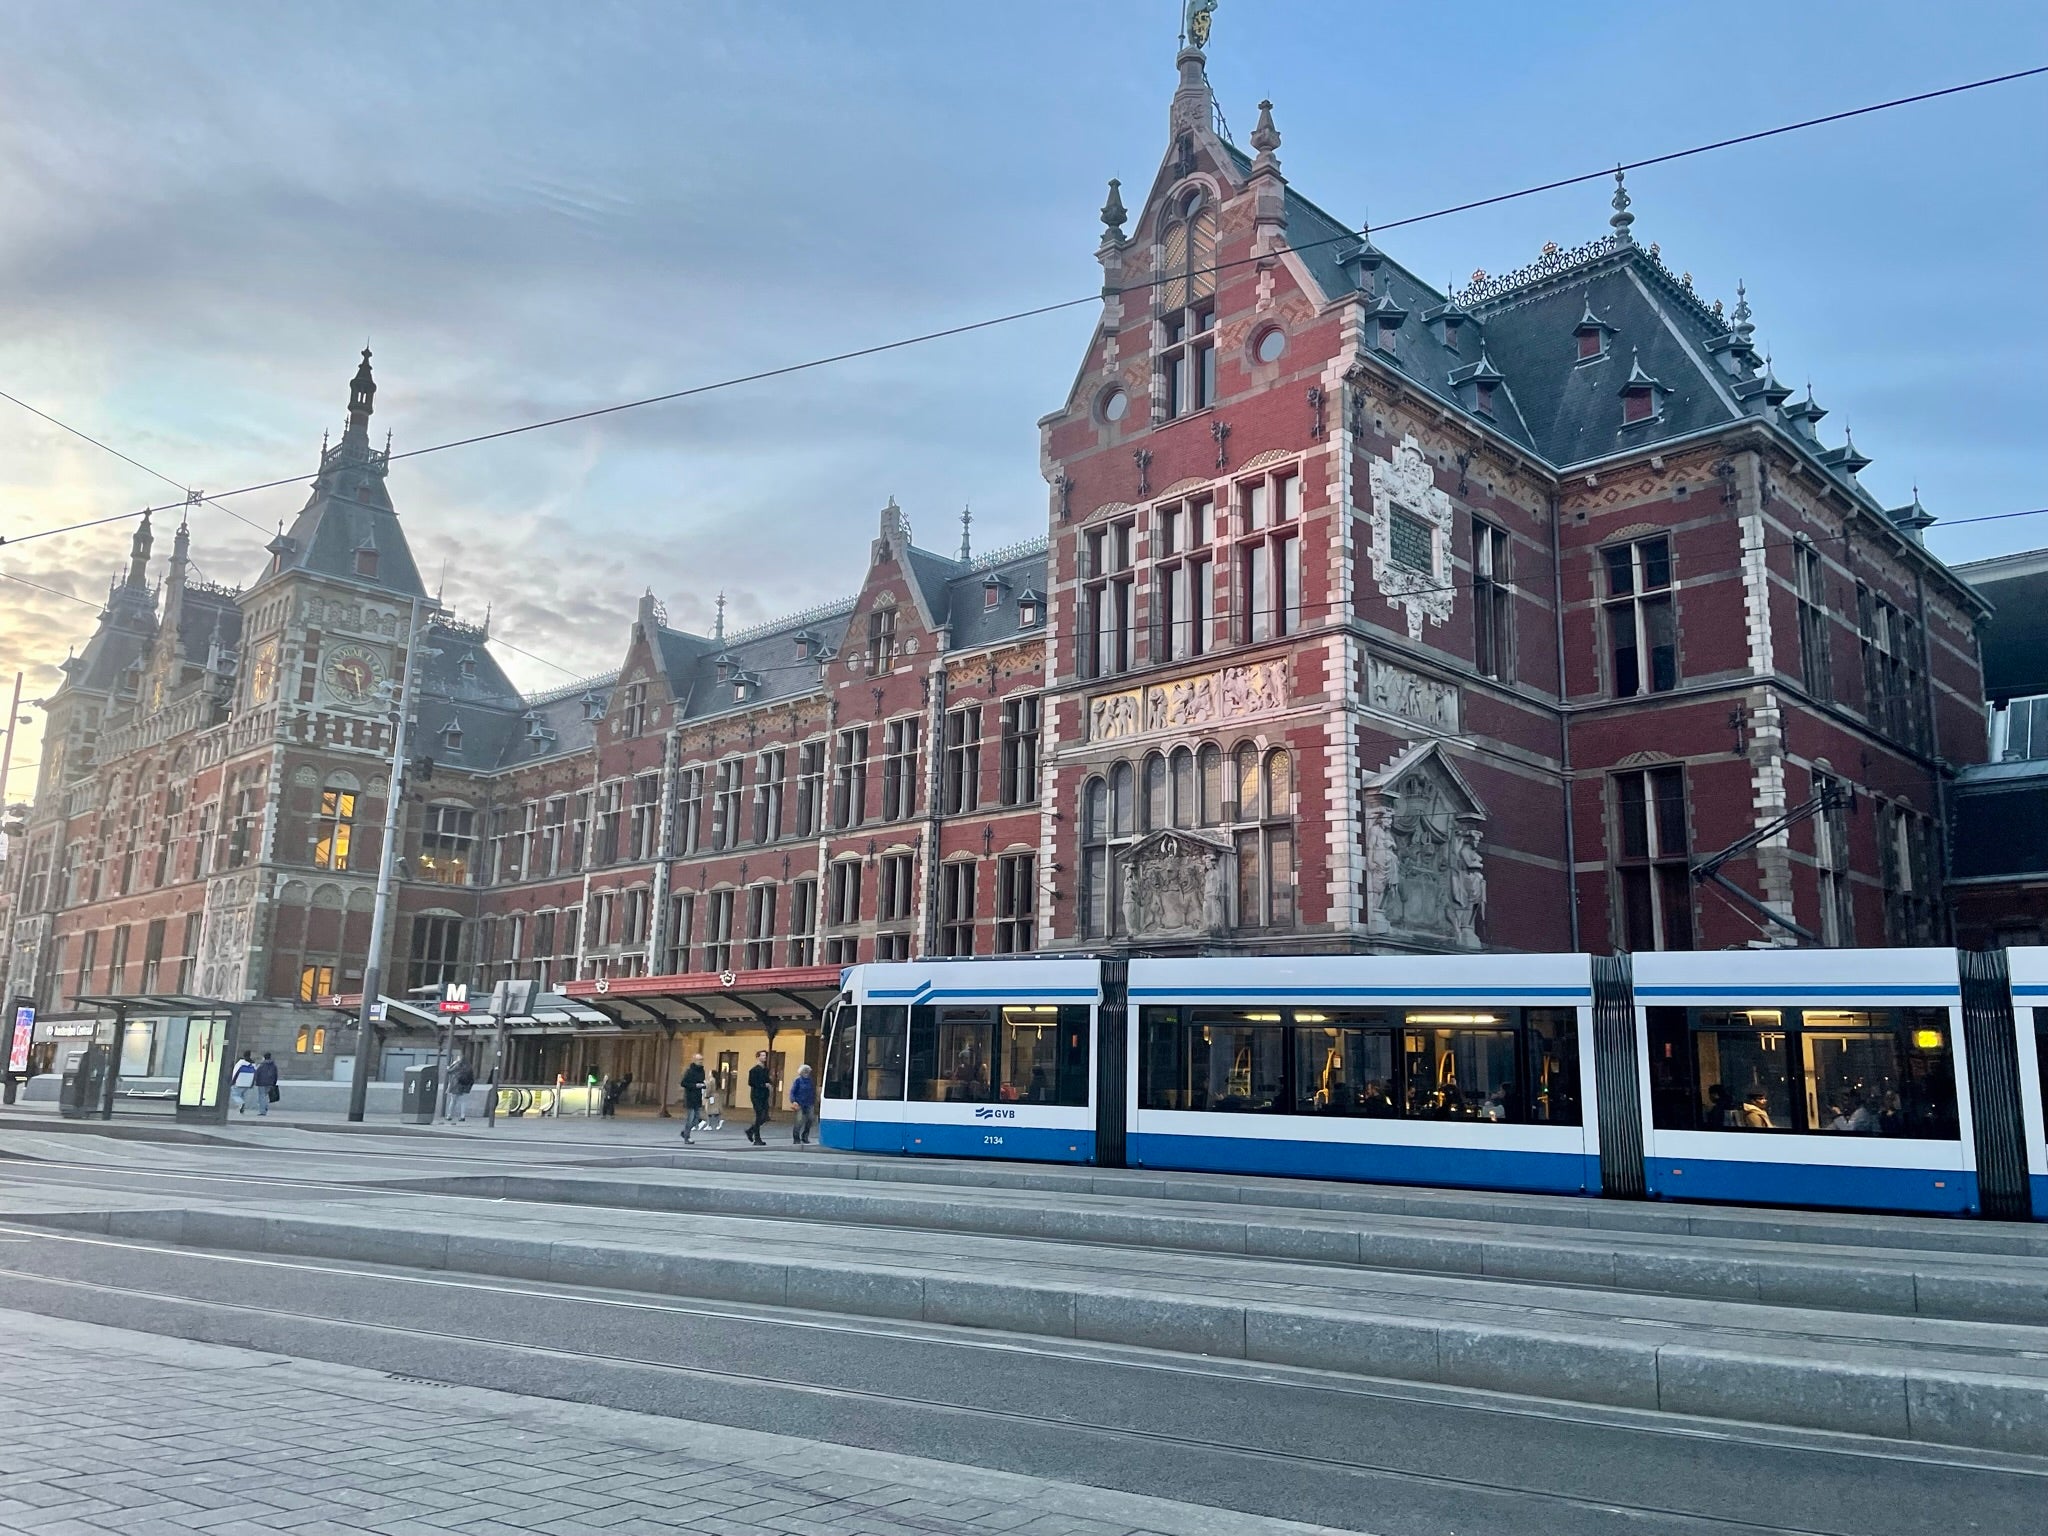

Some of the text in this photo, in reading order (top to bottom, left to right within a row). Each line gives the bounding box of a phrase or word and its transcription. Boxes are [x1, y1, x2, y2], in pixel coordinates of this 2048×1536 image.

[446, 983, 467, 1002] M
[994, 1109, 1015, 1119] GVB
[983, 1135, 1004, 1145] 2134
